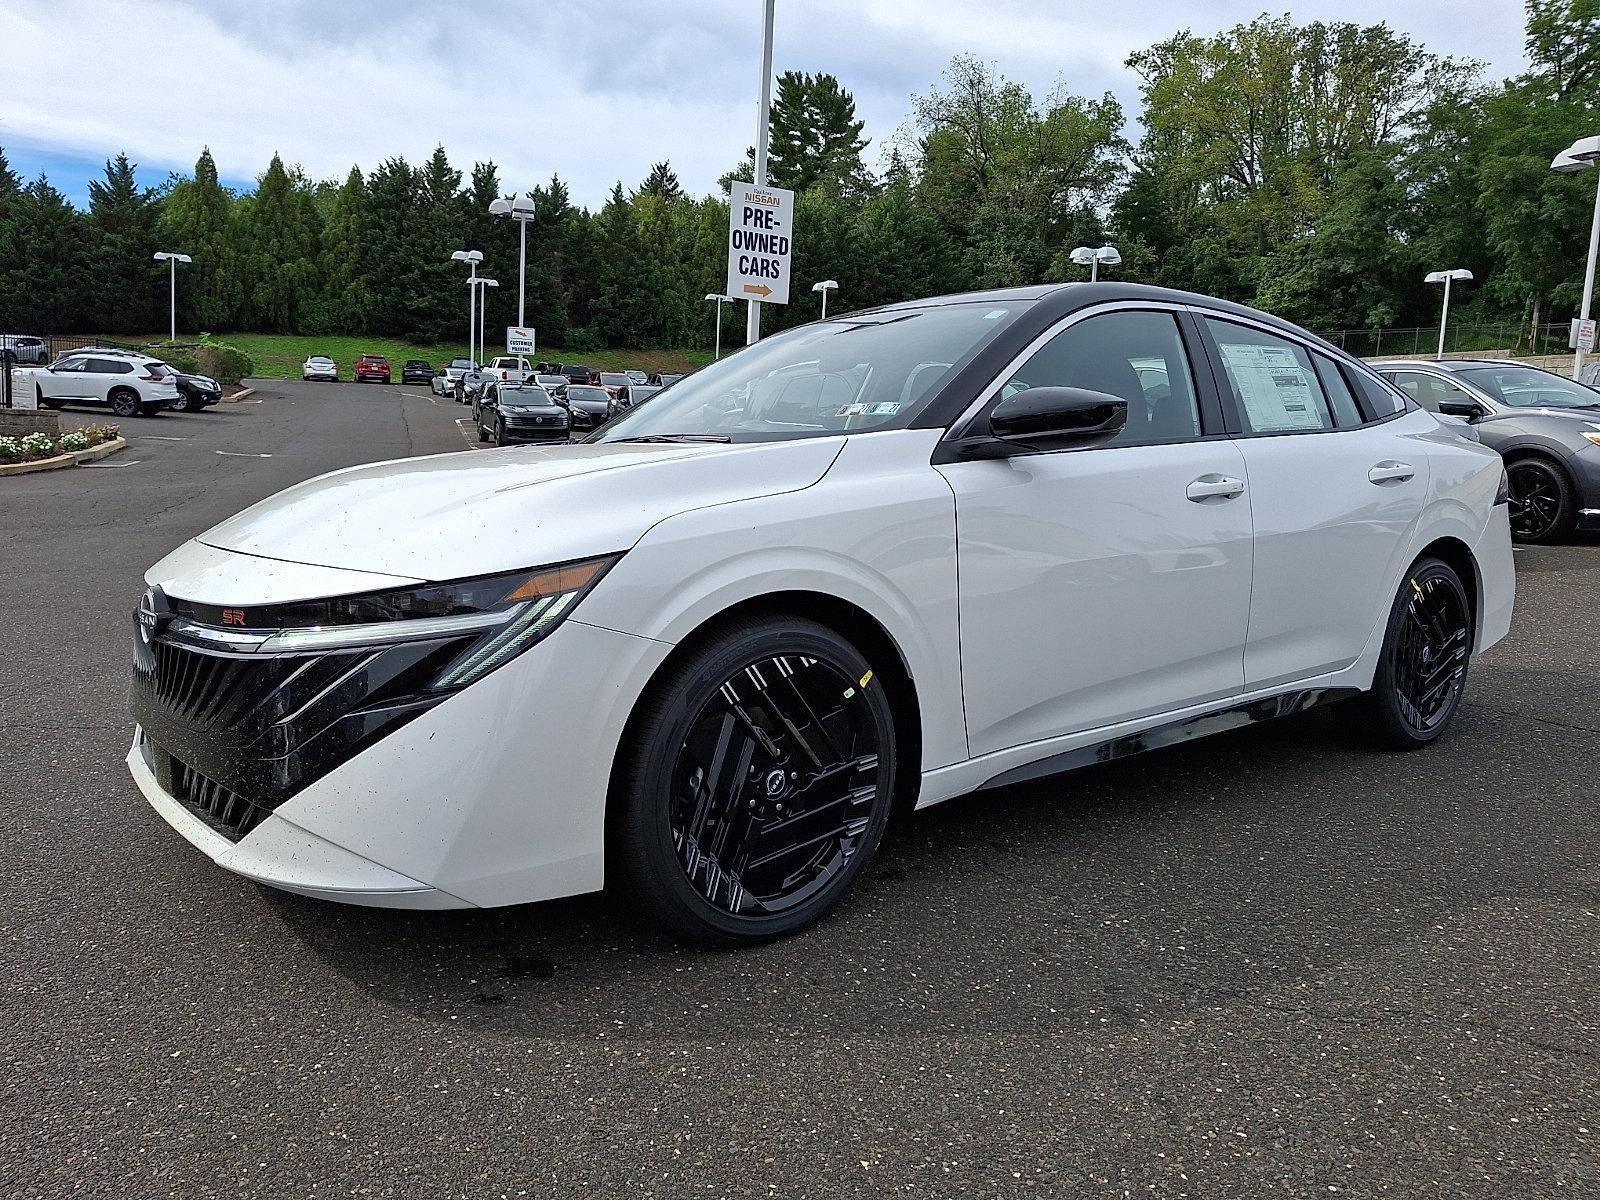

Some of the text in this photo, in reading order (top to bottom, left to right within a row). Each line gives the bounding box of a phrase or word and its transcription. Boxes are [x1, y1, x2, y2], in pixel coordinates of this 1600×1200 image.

[744, 192, 780, 206] NISSAN
[743, 206, 780, 230] PRE-
[732, 229, 789, 256] OWNED
[738, 255, 780, 279] CARS
[222, 608, 246, 625] SR
